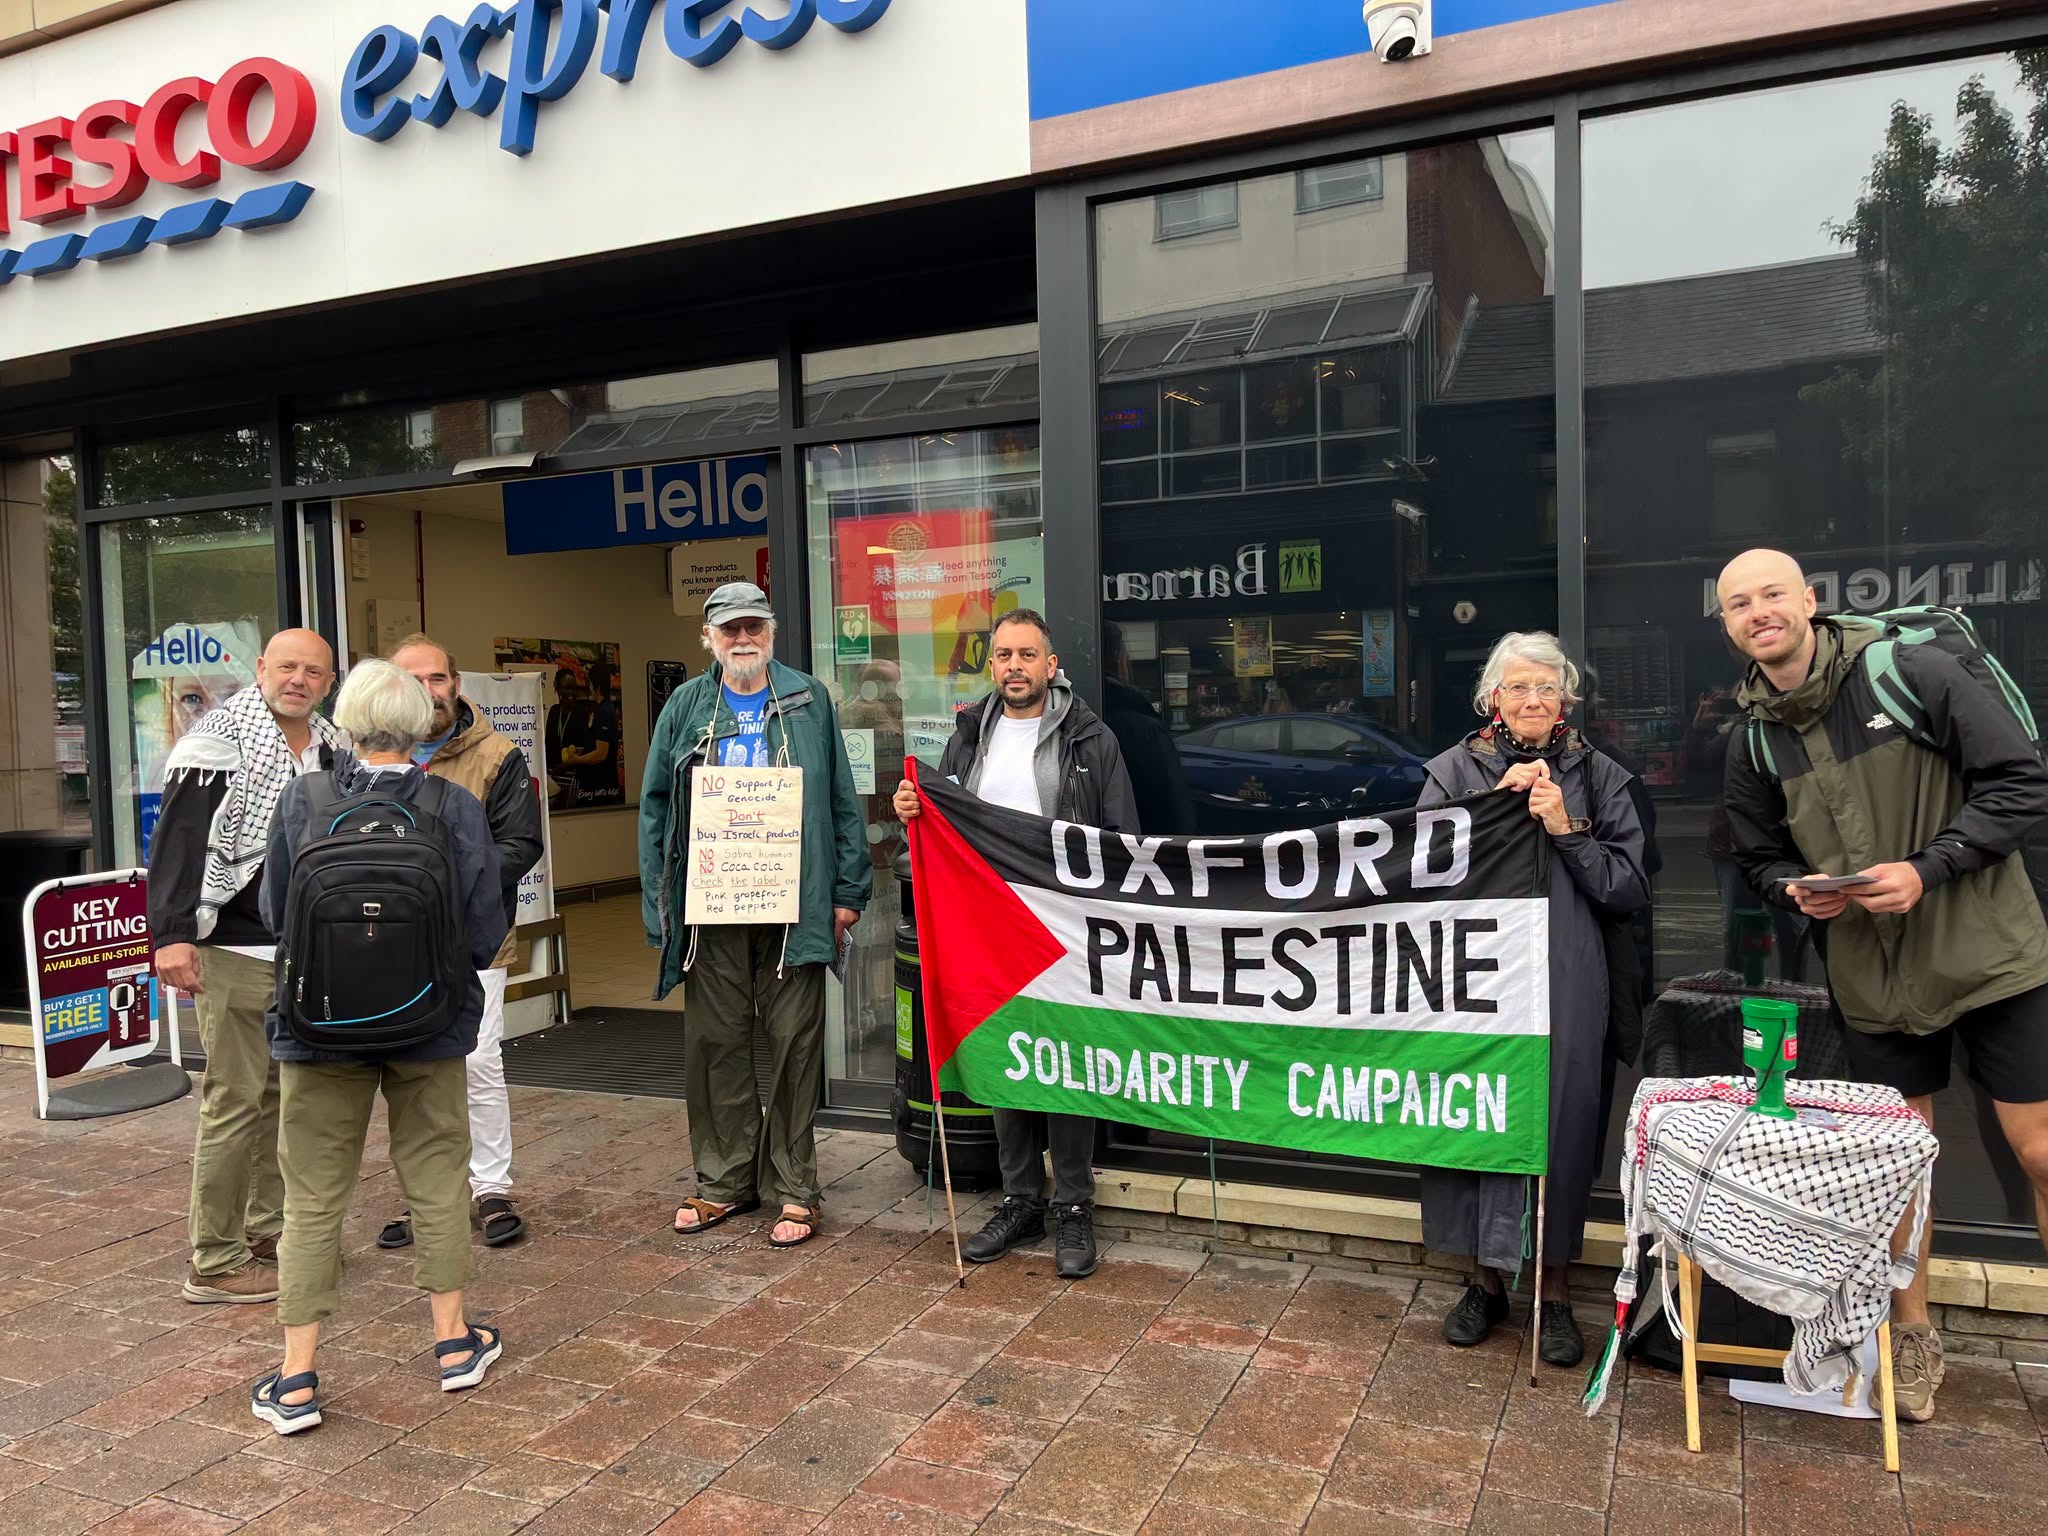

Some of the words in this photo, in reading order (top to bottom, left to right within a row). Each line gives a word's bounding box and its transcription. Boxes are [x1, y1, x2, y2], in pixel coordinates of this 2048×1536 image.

[612, 459, 768, 533] Hello
[690, 565, 704, 573] The
[705, 564, 738, 574] products
[966, 556, 1007, 569] anything
[681, 578, 694, 586] you
[695, 576, 714, 584] know
[944, 573, 967, 583] from
[970, 568, 1002, 581] Tesco?
[688, 587, 706, 597] price
[839, 610, 855, 619] AED
[146, 628, 231, 667] Hello.
[476, 703, 490, 715] he
[493, 703, 536, 718] products
[493, 720, 519, 731] know
[521, 720, 537, 731] and
[921, 719, 936, 732] 8p
[912, 736, 934, 748] you
[702, 775, 725, 793] NO
[777, 779, 792, 791] for
[727, 793, 776, 802] Genocide
[725, 809, 766, 824] Don't
[697, 827, 716, 841] buy
[766, 829, 799, 843] products
[699, 848, 714, 861] NO
[724, 848, 752, 859] Sabra
[1050, 805, 1473, 900] OXFORD
[700, 862, 714, 874] NO
[721, 862, 750, 872] Coca
[533, 872, 544, 883] for
[731, 876, 748, 885] the
[753, 876, 778, 885] label
[518, 892, 539, 904] ogo.
[706, 892, 727, 901] Pink
[734, 890, 787, 902] grapefruit
[73, 896, 119, 923] KEY
[706, 905, 723, 913] Red
[734, 903, 777, 914] peppers
[43, 915, 147, 950] CUTTING
[44, 954, 100, 973] AVAILABLE
[102, 945, 150, 961] IN-STORE
[1086, 916, 1499, 1015] PALESTINE
[122, 965, 145, 973] CUTTING
[44, 1000, 64, 1012] BUY
[67, 999, 73, 1008] 2
[74, 994, 94, 1005] GET
[45, 1003, 102, 1033] FREE
[89, 1022, 103, 1030] ONLY
[1004, 1031, 1249, 1111] SOLIDARITY
[1288, 1061, 1507, 1134] CAMPAIGN
